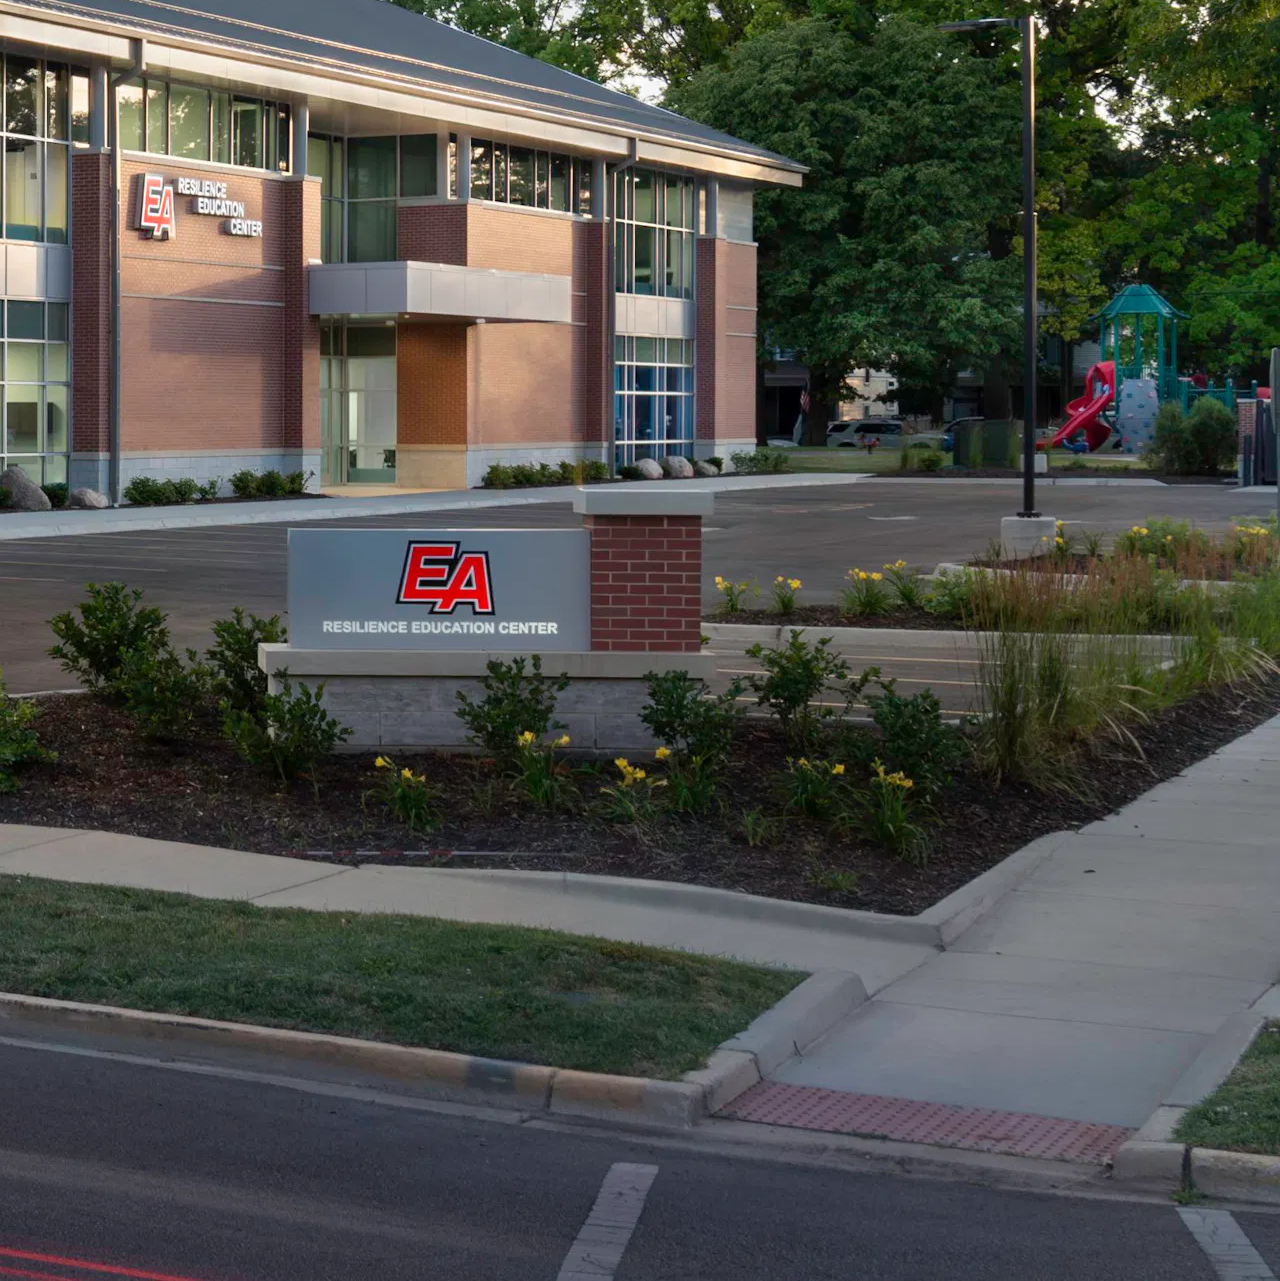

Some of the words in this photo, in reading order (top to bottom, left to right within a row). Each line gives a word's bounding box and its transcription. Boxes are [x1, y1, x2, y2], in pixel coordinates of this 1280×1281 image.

[177, 177, 227, 198] RESILIENCE
[141, 174, 176, 238] EA
[197, 197, 245, 217] EDUCATION
[230, 219, 262, 237] CENTER
[396, 540, 495, 615] EA
[322, 620, 408, 634] RESILIENCE
[410, 621, 495, 635] EDUCATION
[498, 621, 558, 635] CENTER
